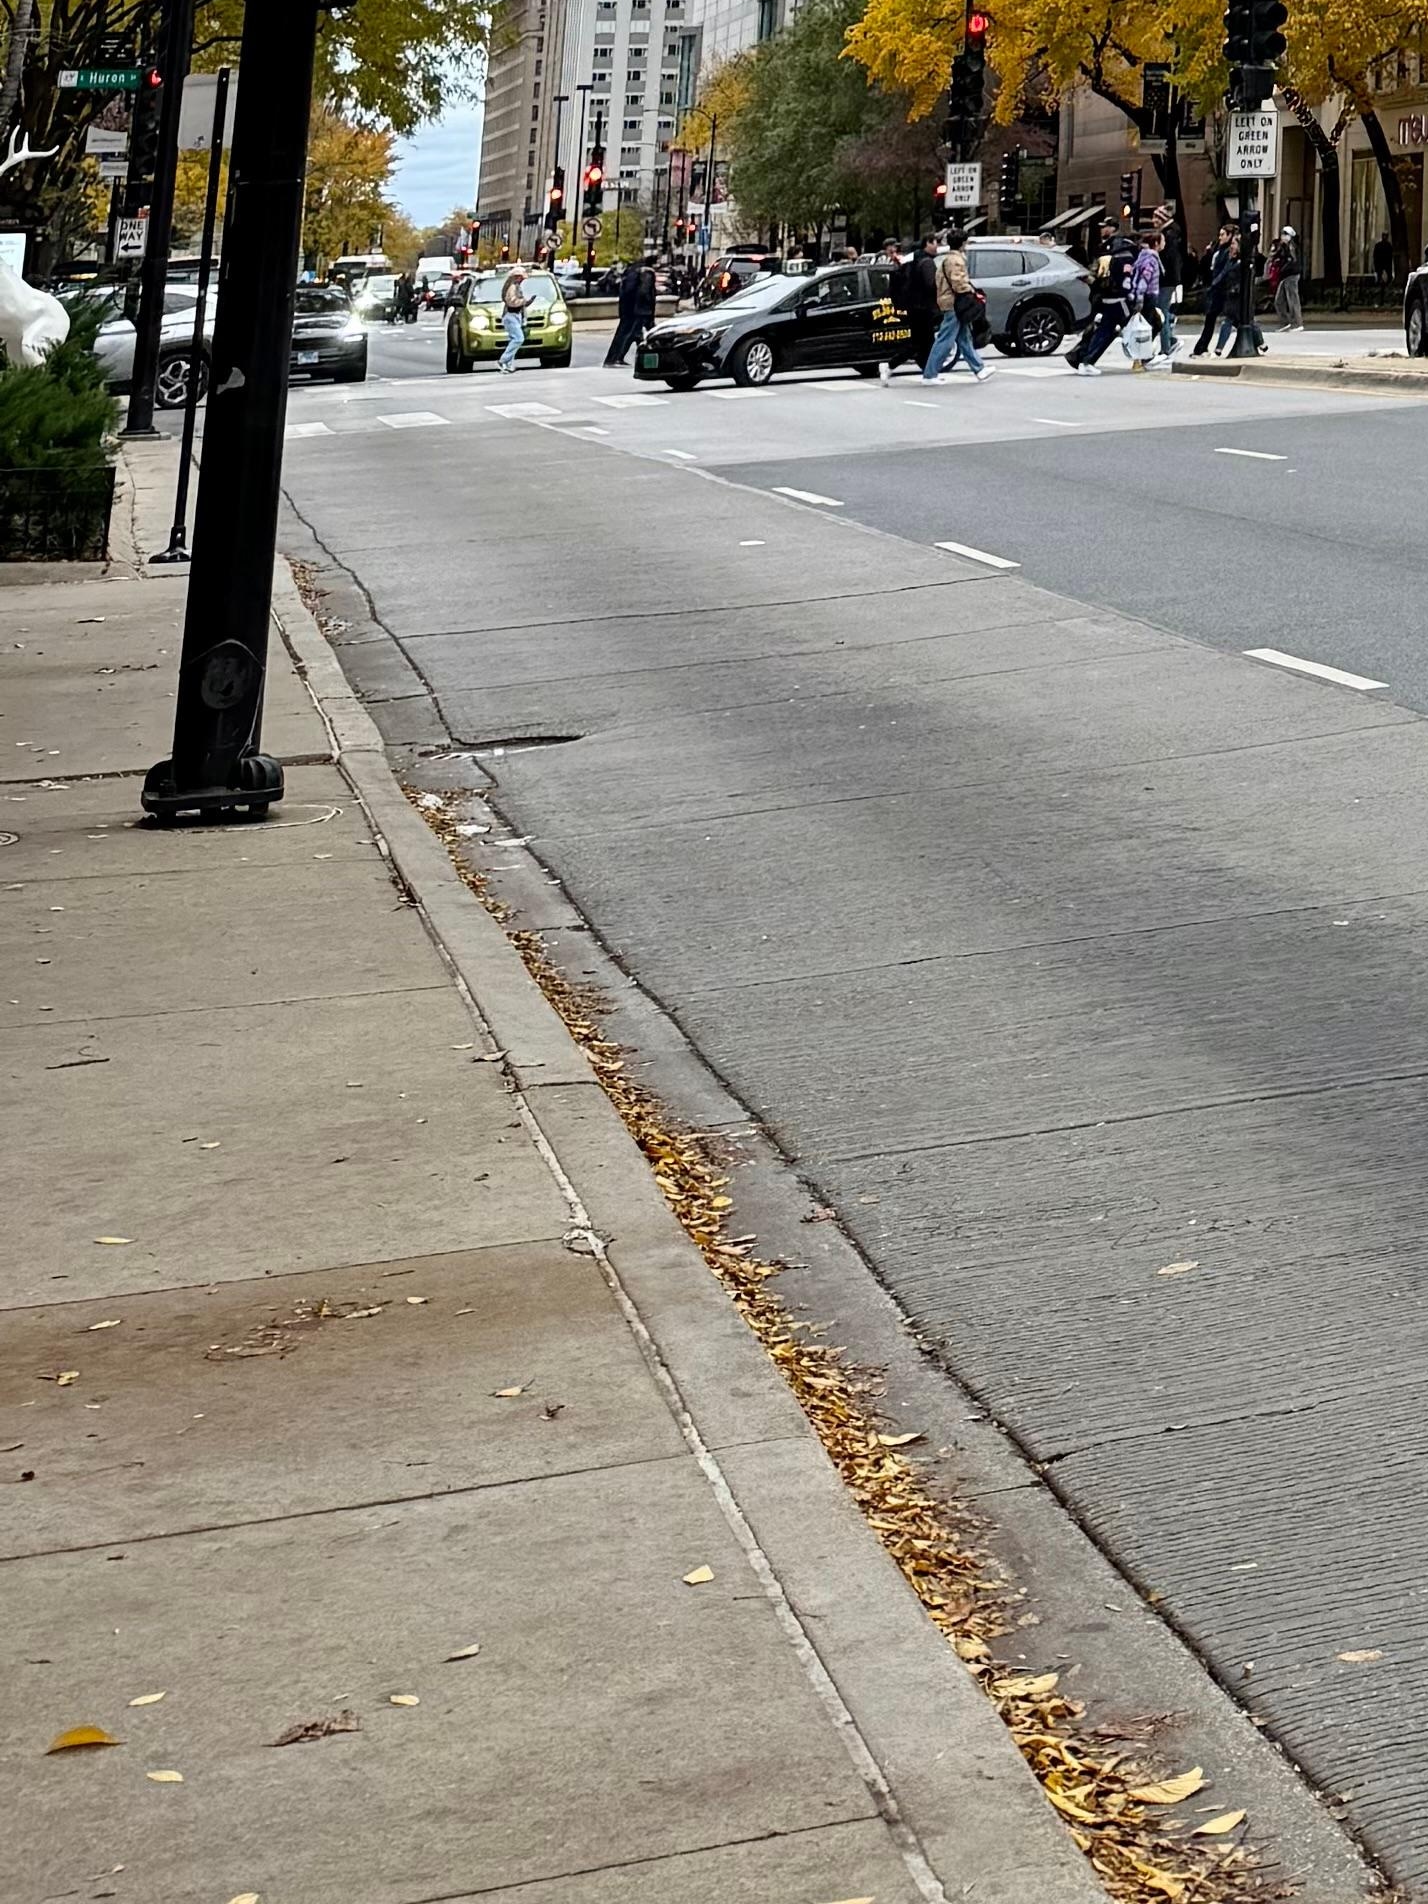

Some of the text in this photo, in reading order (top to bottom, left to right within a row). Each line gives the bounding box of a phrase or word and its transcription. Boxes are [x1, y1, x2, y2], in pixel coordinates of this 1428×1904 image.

[89, 72, 125, 84] Huron
[1235, 116, 1273, 128] LEFT ON
[1238, 131, 1268, 141] GREEN
[1236, 145, 1269, 155] ARROW
[1240, 158, 1263, 169] ONLY
[120, 220, 144, 231] ONE
[119, 231, 144, 242] WAY
